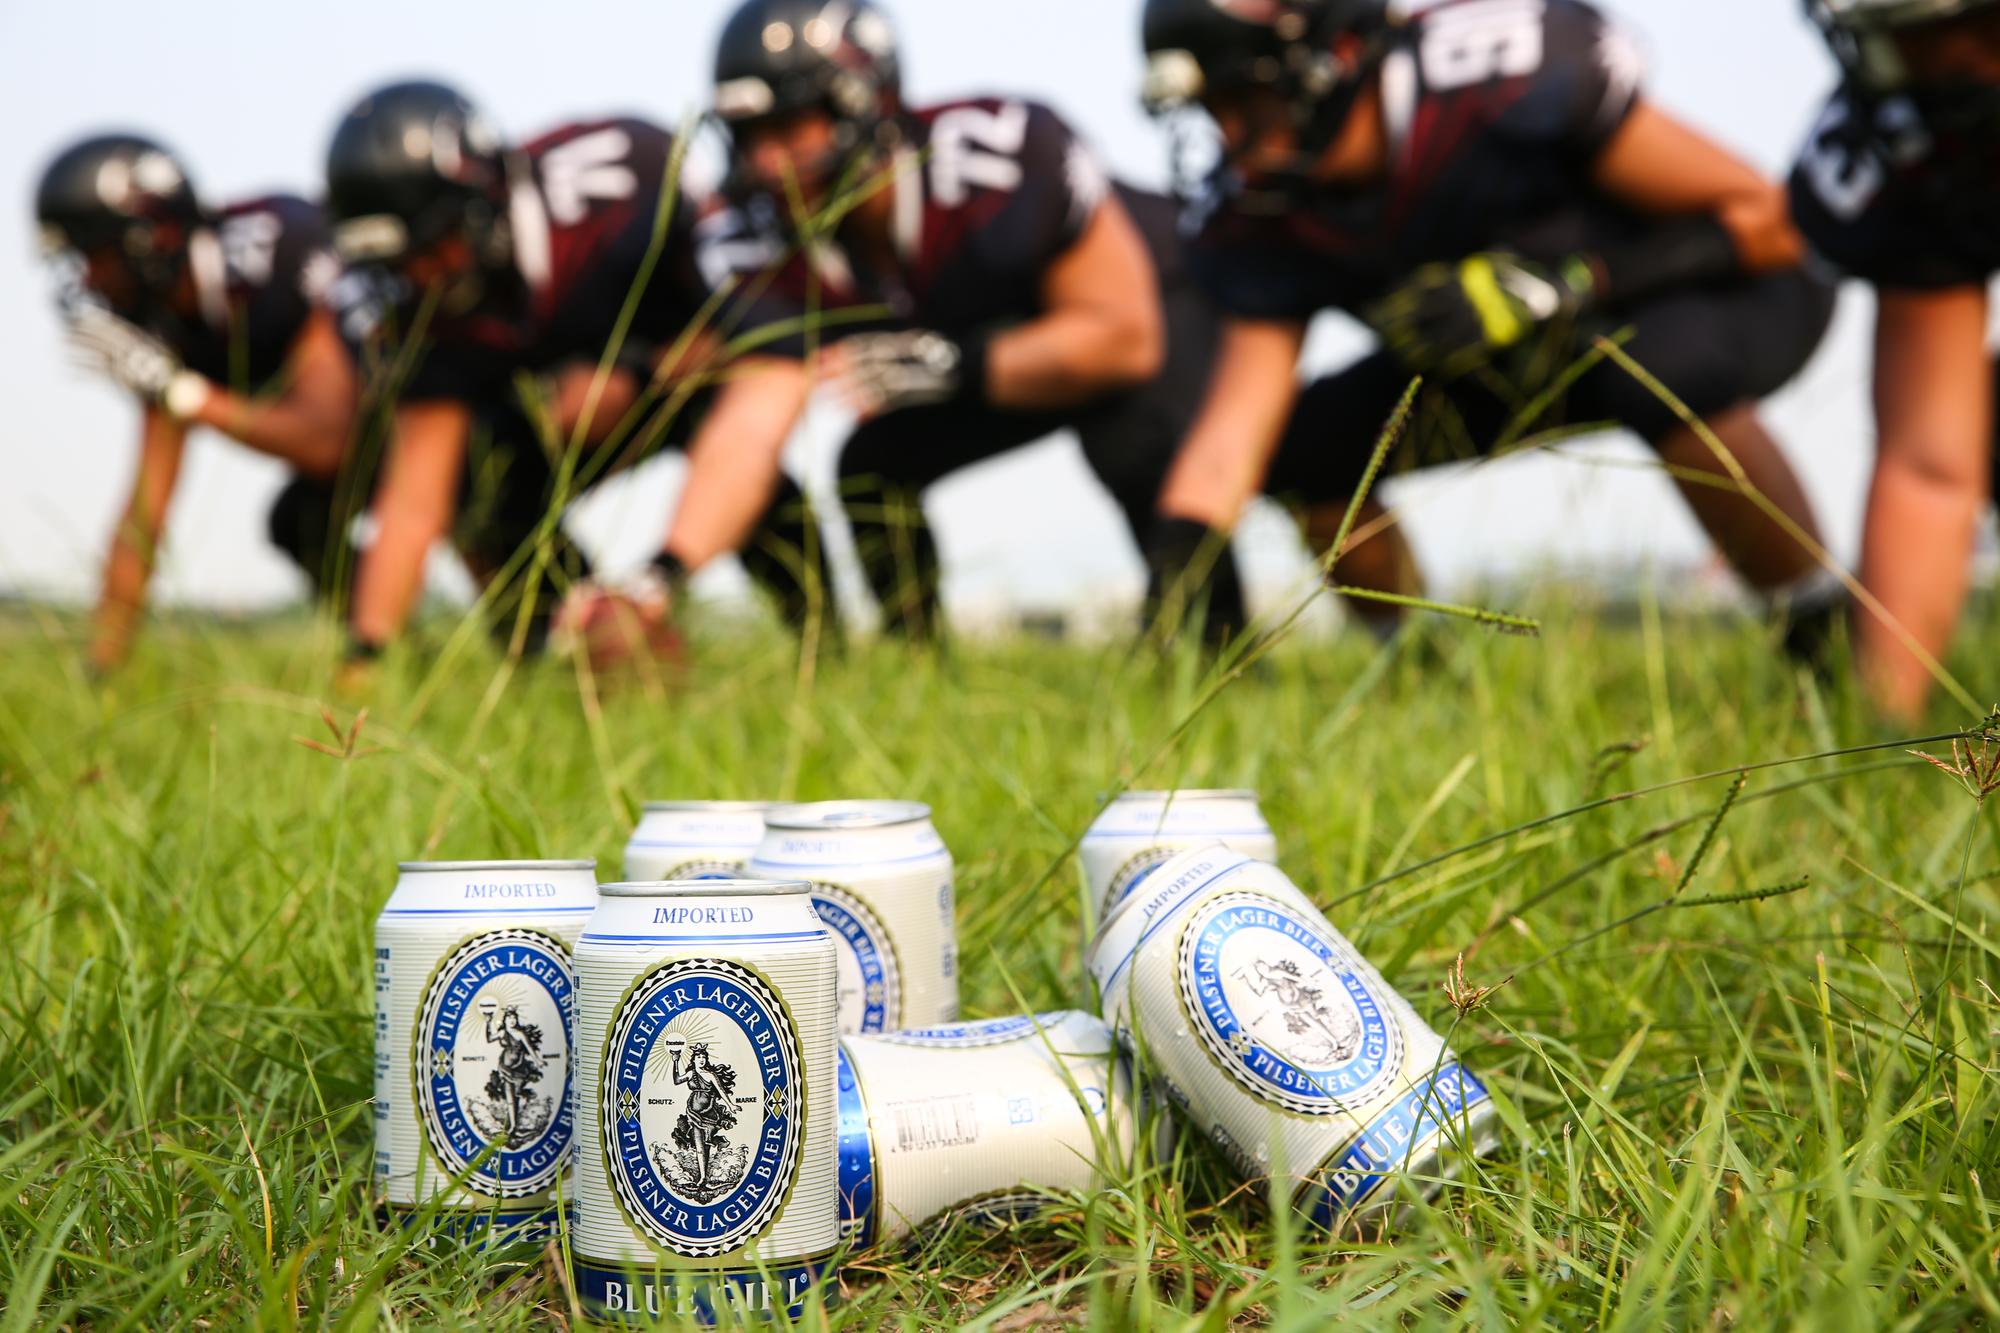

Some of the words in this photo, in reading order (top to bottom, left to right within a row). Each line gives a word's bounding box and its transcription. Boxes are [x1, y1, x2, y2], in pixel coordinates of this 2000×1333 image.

[464, 882, 556, 898] IMPORTED
[652, 906, 754, 924] IMPORTED
[1142, 861, 1214, 918] IMPORTED
[437, 954, 504, 1042] PILSENER
[508, 951, 565, 994] LAGER
[1199, 931, 1232, 1029] PILSENER
[1217, 908, 1281, 933] LAGER
[1347, 978, 1378, 1018] BIER
[623, 985, 693, 1082] PILSENER
[696, 983, 763, 1034] LAGER
[755, 1027, 783, 1083] BIER
[1356, 1022, 1385, 1079] LAGER
[1253, 1053, 1352, 1093] PILSENER
[437, 1085, 499, 1175] PILSENR
[507, 1131, 567, 1176] LAGER
[623, 1129, 689, 1231] PILSENER
[696, 1183, 765, 1232] LAGER
[754, 1124, 783, 1180] BIER
